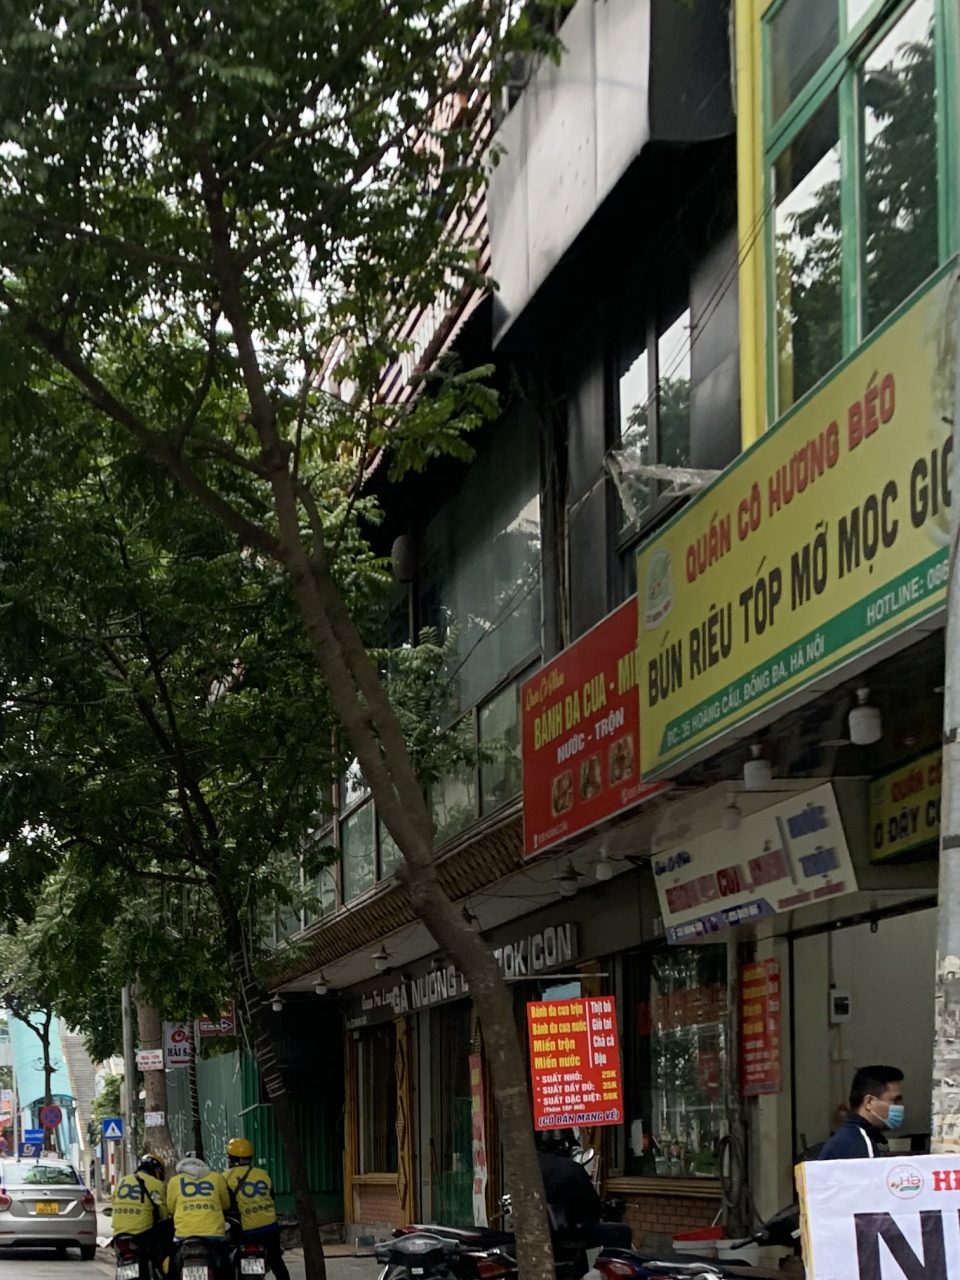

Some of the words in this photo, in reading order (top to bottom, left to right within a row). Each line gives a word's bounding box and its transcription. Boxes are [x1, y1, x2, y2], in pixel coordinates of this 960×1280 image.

[685, 510, 731, 584] QUÁN
[737, 480, 762, 542] CÔ
[768, 420, 840, 518] HƯƠNG
[847, 370, 897, 453] BÉO
[648, 630, 683, 708] BÚN
[689, 602, 733, 681] RIÊU
[739, 555, 783, 644] TÓP
[790, 519, 829, 612] MỠ
[837, 479, 900, 579] MỌC
[866, 578, 925, 627] HOTLINE:
[583, 671, 607, 719] CUA
[595, 707, 625, 741] TRỘN
[533, 1037, 556, 1052] Miến
[557, 1037, 576, 1052] trộn
[534, 1053, 557, 1069] Miến
[558, 1054, 581, 1067] nước
[601, 1070, 616, 1079] 25K
[602, 1081, 617, 1090] 35K
[575, 1110, 603, 1122] MANG
[180, 1177, 215, 1198] be
